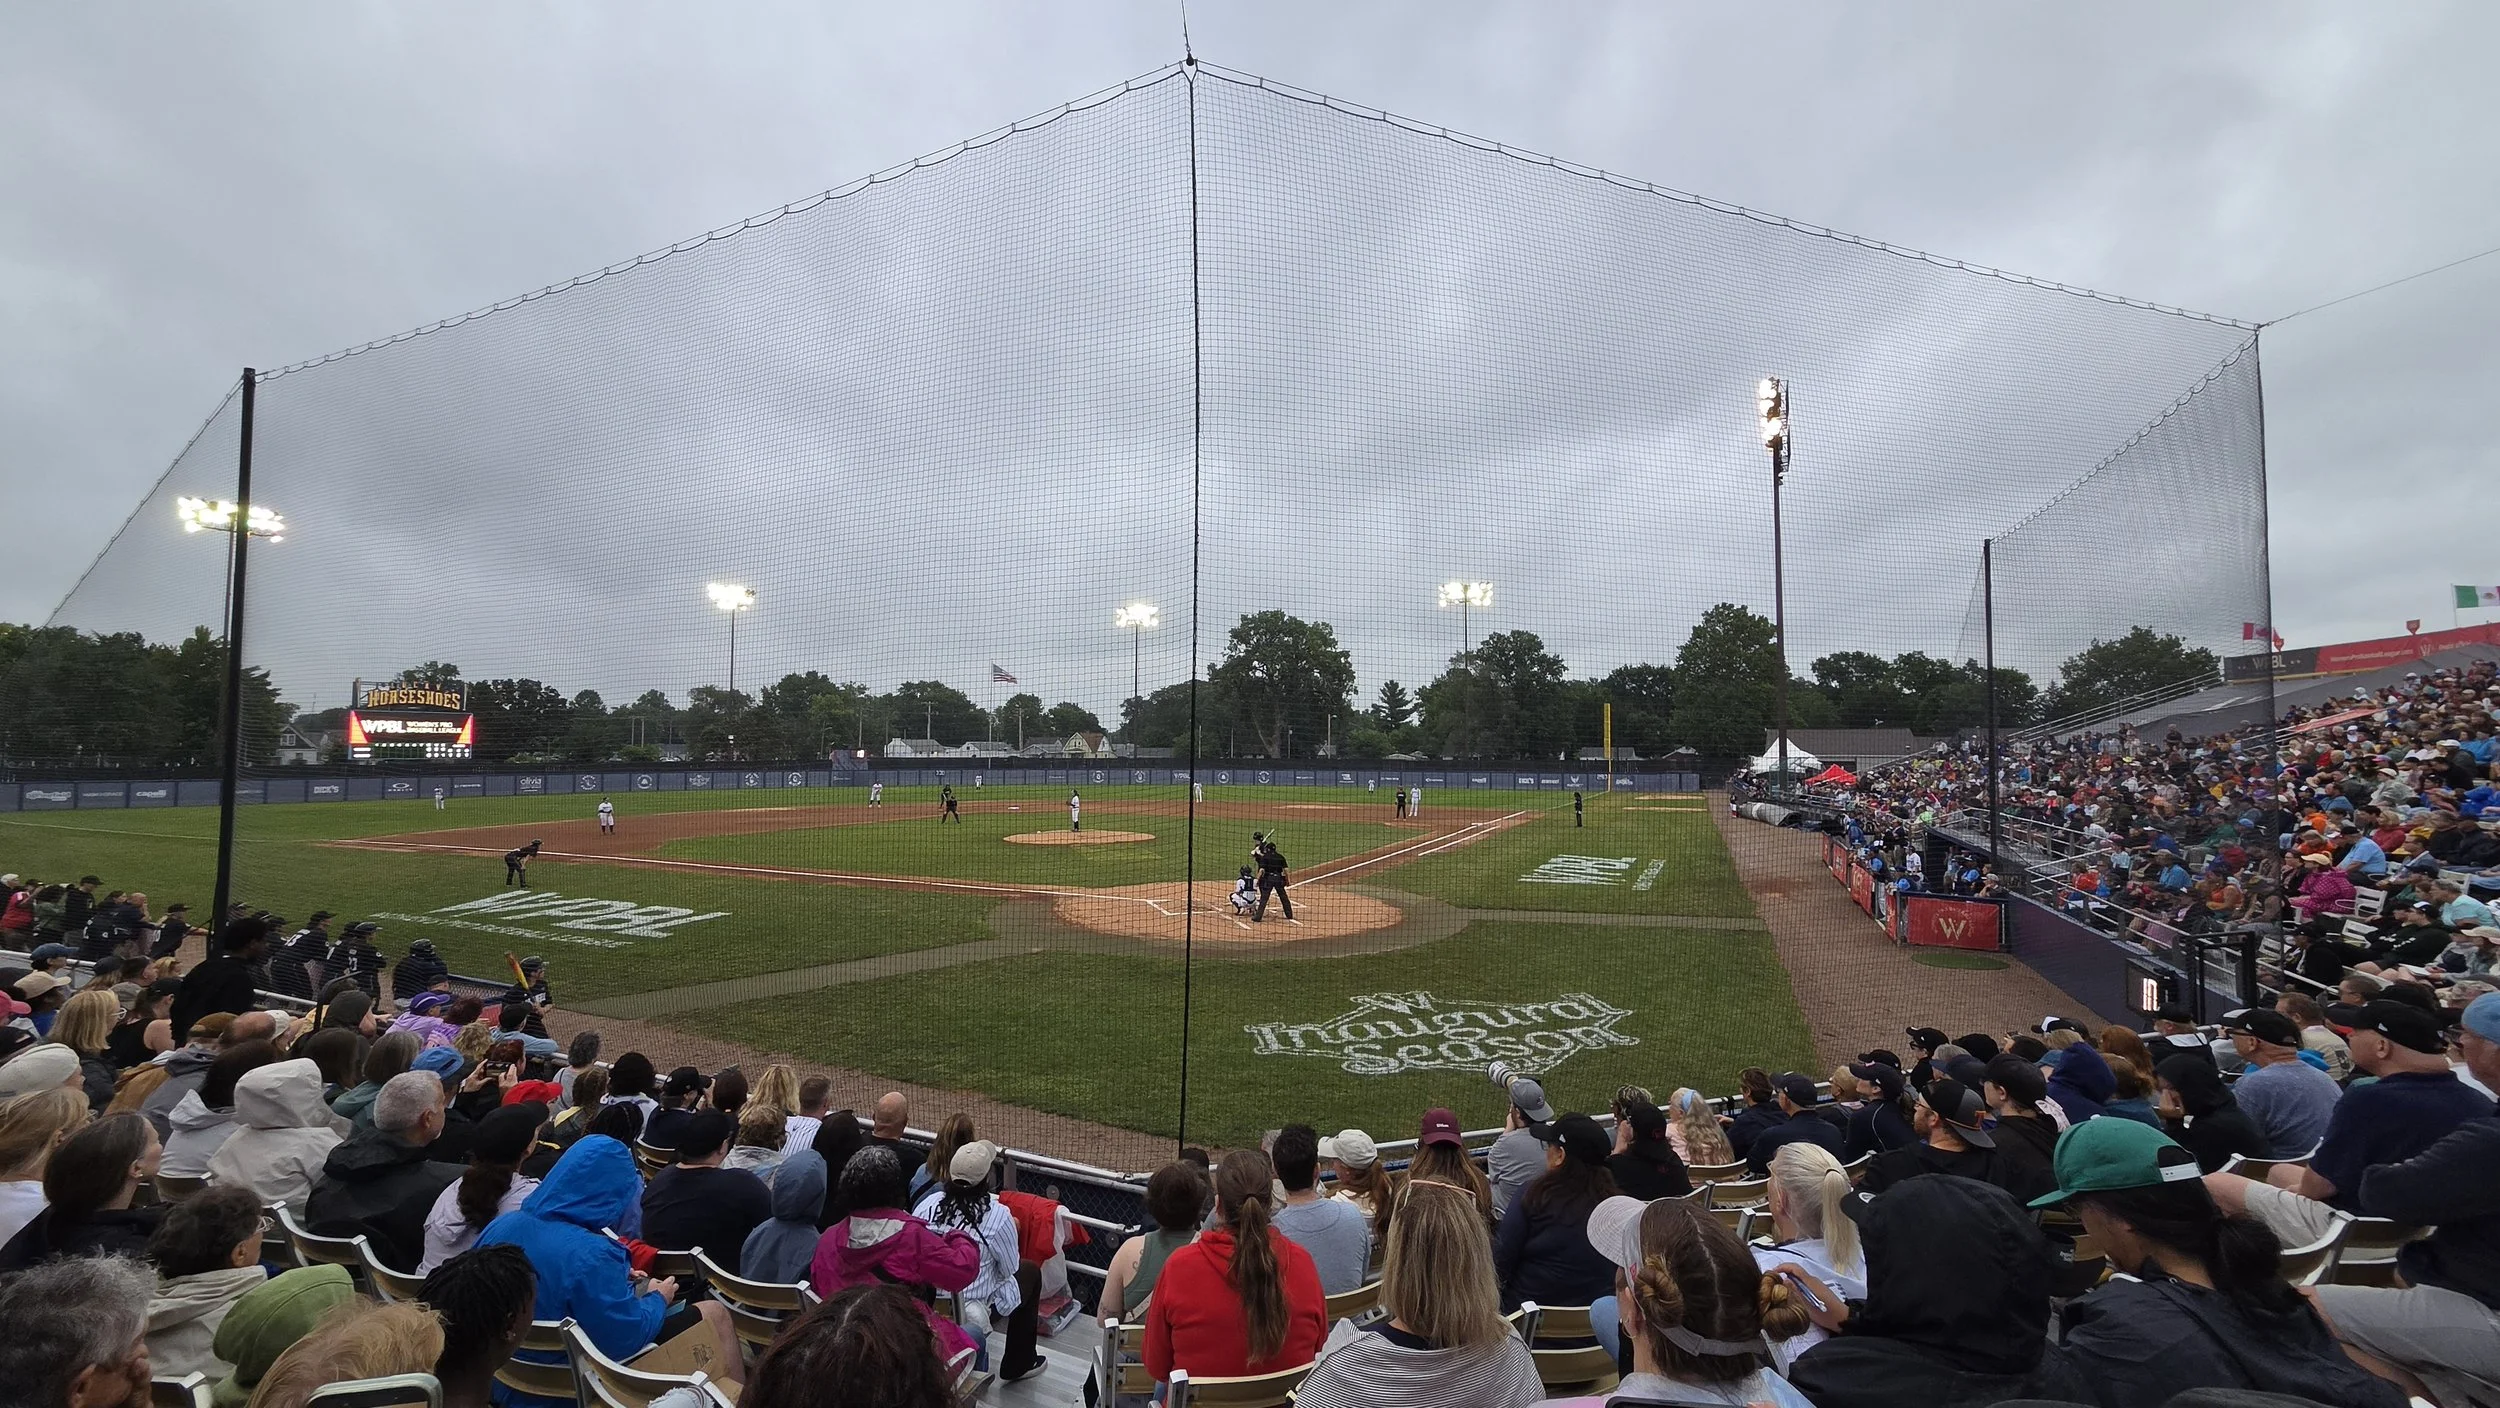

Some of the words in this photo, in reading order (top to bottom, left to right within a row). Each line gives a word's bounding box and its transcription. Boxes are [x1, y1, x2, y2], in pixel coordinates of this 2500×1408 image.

[367, 689, 461, 711] HORSESHOES
[360, 719, 407, 734] WPBL
[314, 785, 340, 794] DICK'S
[424, 890, 732, 938] WPBL
[1243, 992, 1634, 1055] Inaugural
